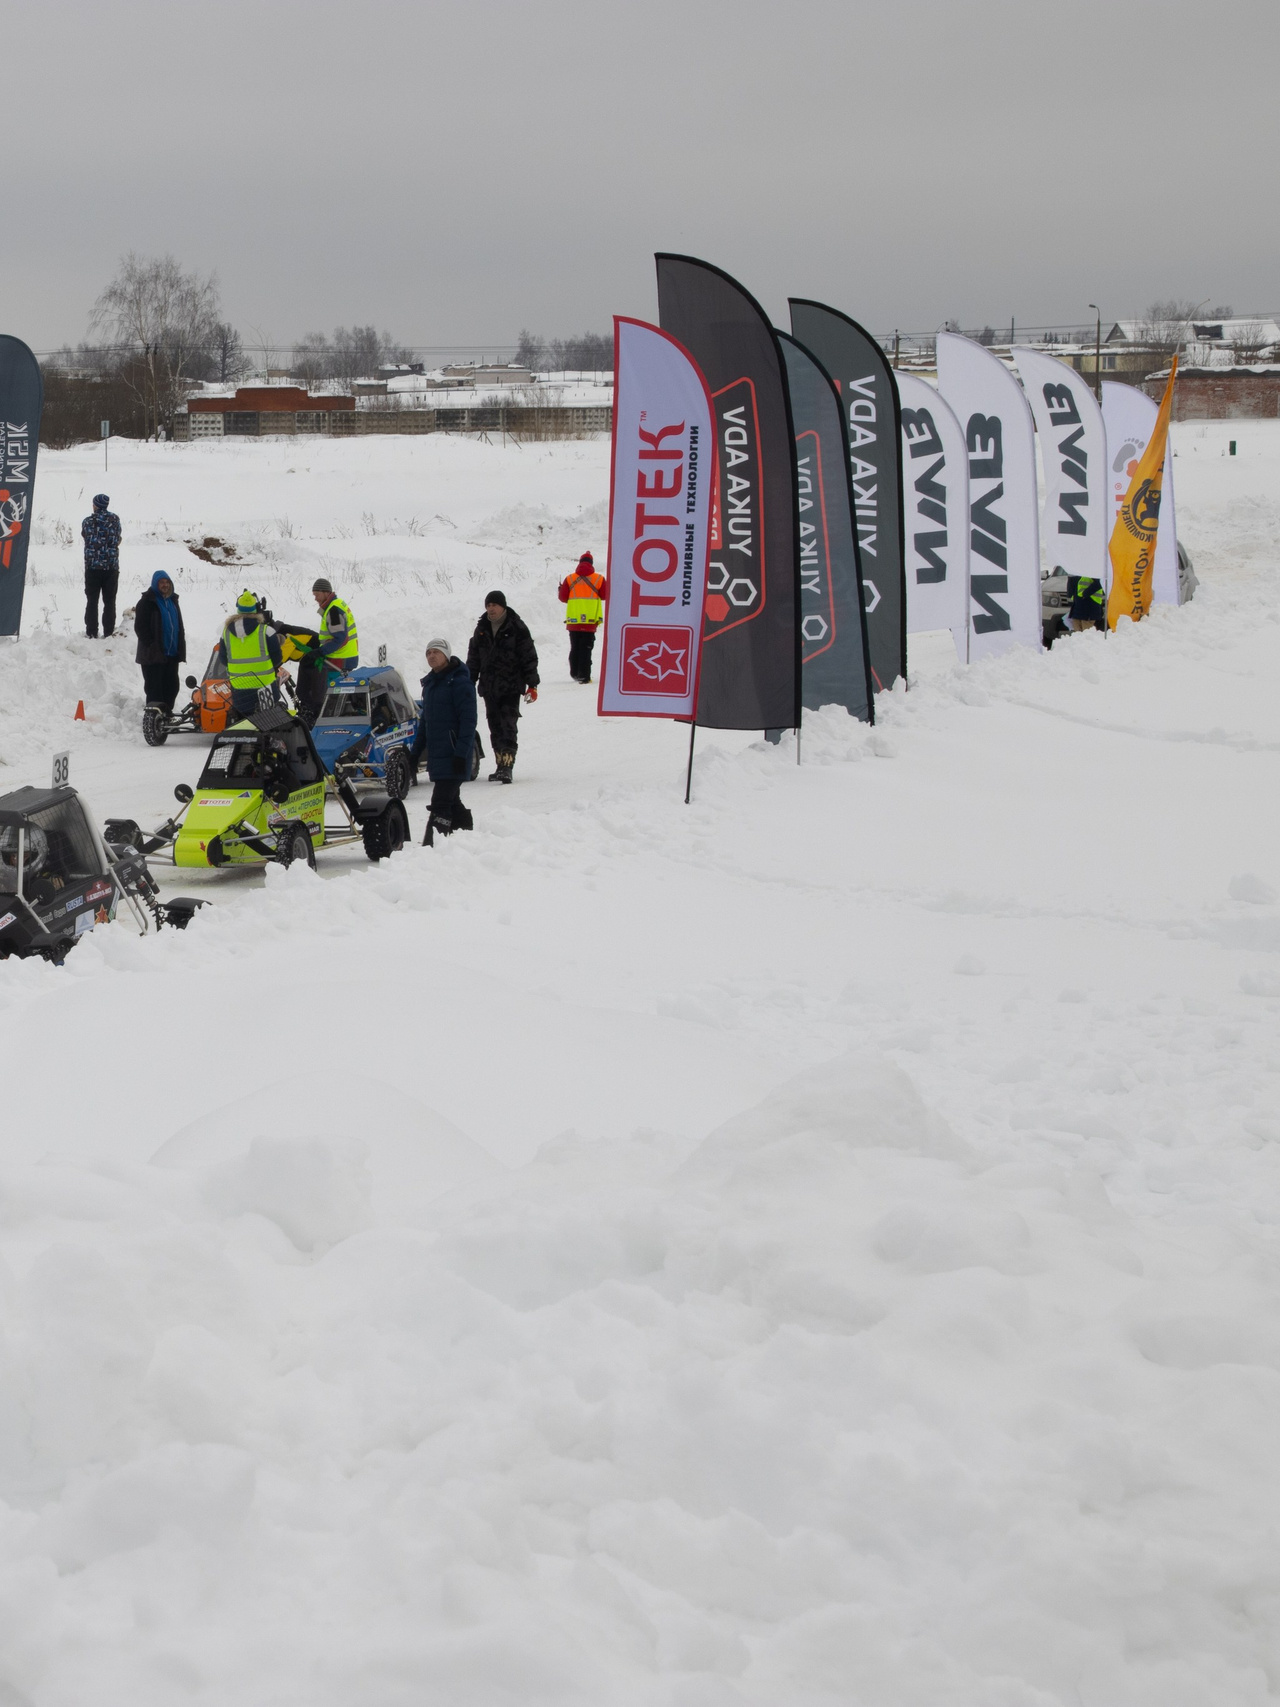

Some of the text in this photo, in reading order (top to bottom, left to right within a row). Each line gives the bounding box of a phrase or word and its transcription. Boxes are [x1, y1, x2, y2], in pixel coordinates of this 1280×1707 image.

[682, 426, 699, 607] ТОПЛИВНЫЕ ТЕХНОЛОГИИ
[378, 645, 387, 663] 89
[258, 687, 274, 711] 88
[54, 756, 69, 784] 38
